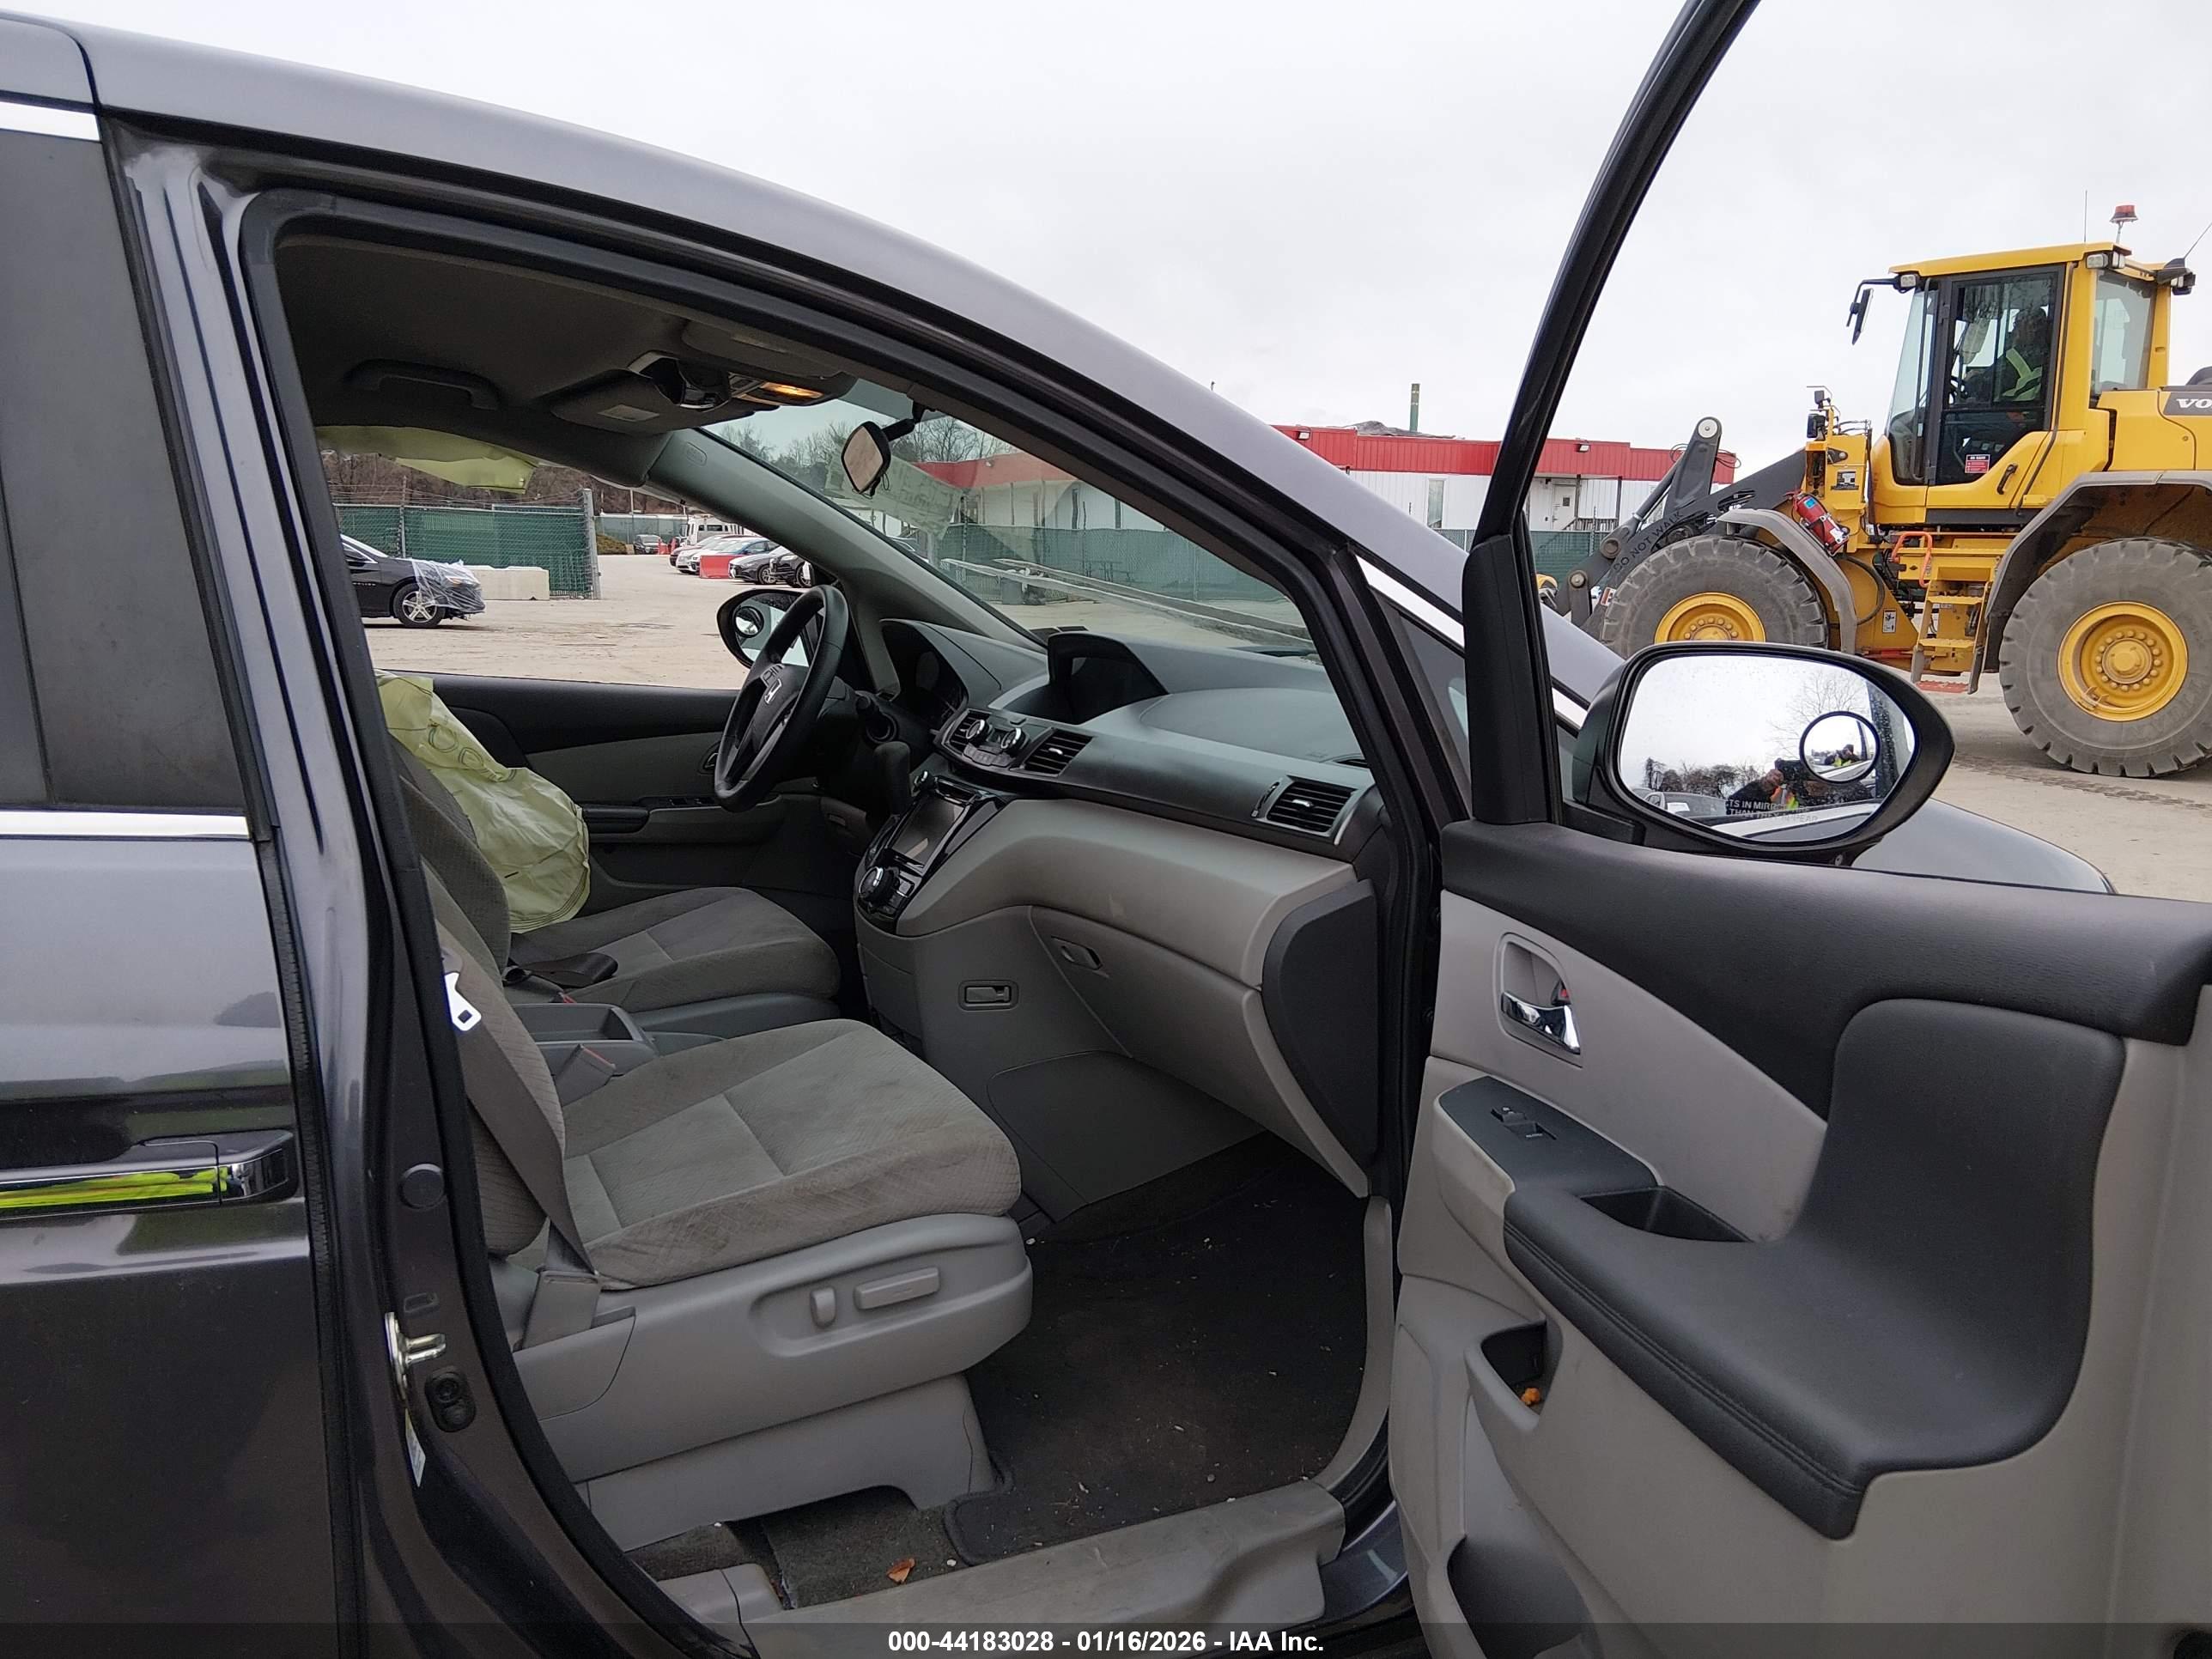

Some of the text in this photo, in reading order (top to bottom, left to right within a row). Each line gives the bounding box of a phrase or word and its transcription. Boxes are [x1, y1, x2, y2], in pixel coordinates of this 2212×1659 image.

[1630, 536, 1652, 558] NOT
[1652, 511, 1684, 537] WALK
[1753, 800, 1789, 811] MIRR
